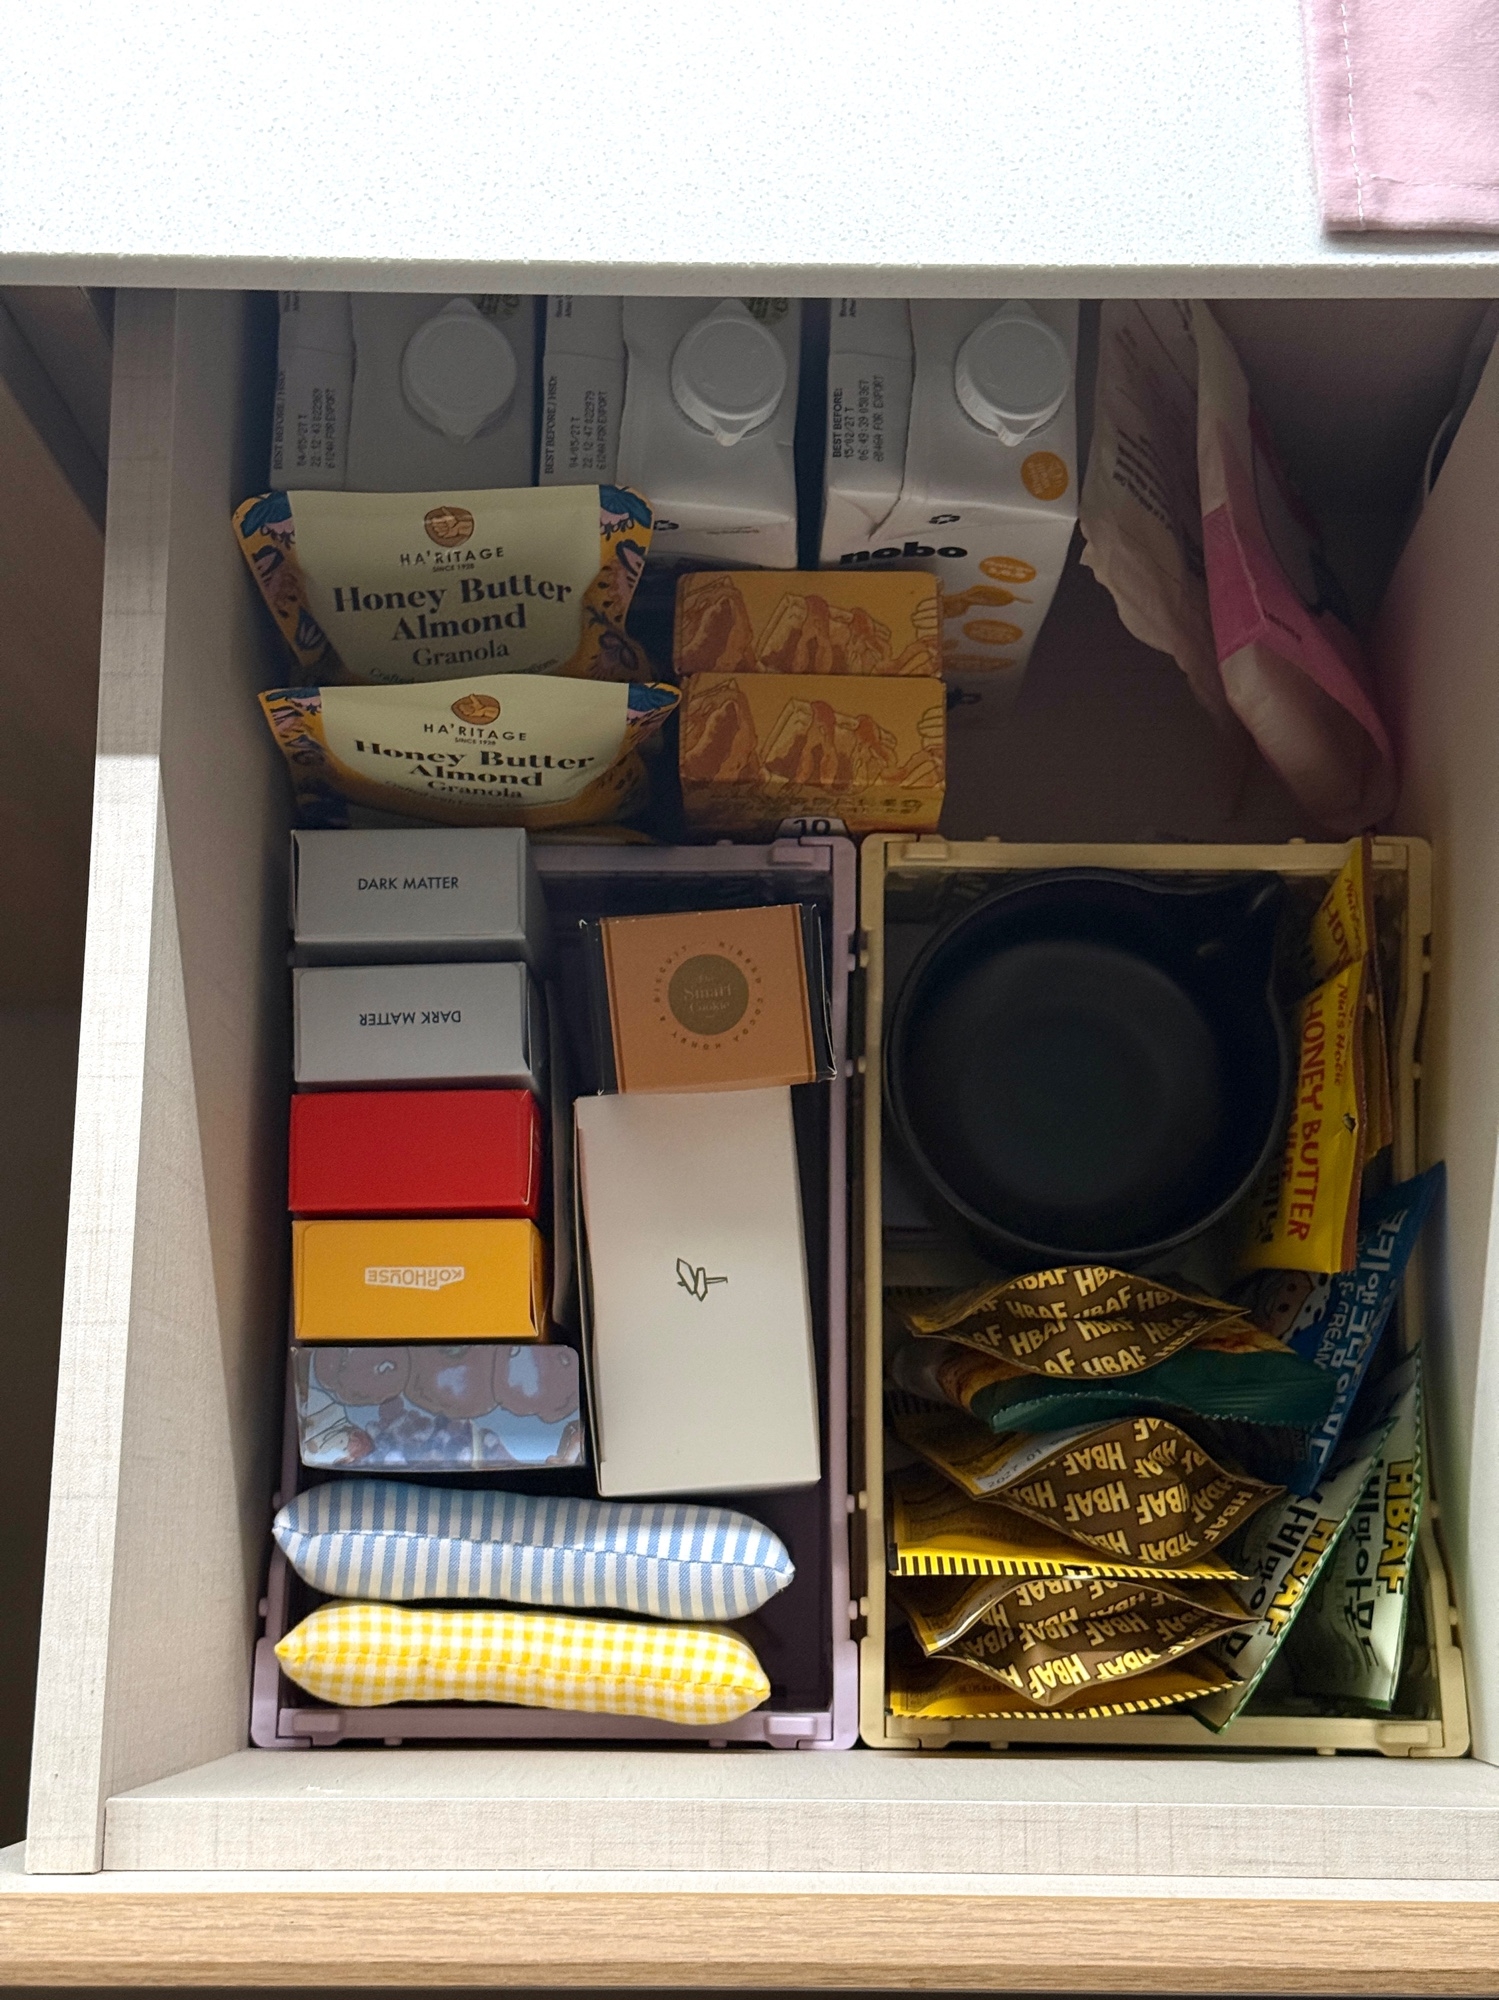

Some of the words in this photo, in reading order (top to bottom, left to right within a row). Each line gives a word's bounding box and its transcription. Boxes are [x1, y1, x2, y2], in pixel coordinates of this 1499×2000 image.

[596, 391, 608, 424] EXPORT
[873, 375, 885, 409] EXPORT
[275, 401, 285, 442] BEFORE
[833, 388, 843, 430] BEFORE:
[874, 413, 884, 431] FOR
[546, 406, 556, 446] BEFORE
[597, 424, 608, 442] FOR
[274, 443, 284, 470] BEST
[544, 448, 555, 474] BEST
[833, 433, 842, 458] BEST
[400, 546, 505, 565] HA'RITAGE
[432, 564, 455, 573] SINCE
[840, 541, 968, 565] nobo
[333, 586, 448, 613] Honey
[460, 574, 572, 603] Butter
[392, 603, 527, 641] Almond
[412, 640, 509, 667] Granola
[424, 723, 527, 741] HA'RITAGE
[455, 737, 477, 745] SINCE
[353, 740, 467, 765] Honey
[480, 750, 595, 770] Butter
[408, 764, 542, 787] Almond
[427, 781, 522, 798] Granola
[358, 877, 398, 890] DARK
[403, 876, 459, 890] MATTER
[653, 945, 688, 1003] BISCUIT
[683, 983, 732, 1000] Smart
[1337, 983, 1349, 1029] Nuts
[359, 1012, 416, 1026] MATTER
[421, 1010, 461, 1024] DARK
[733, 997, 764, 1042] COCOA
[671, 1031, 721, 1050] HONEY
[1300, 994, 1325, 1112] HONEY
[1287, 1118, 1322, 1241] BUTTER
[1008, 1319, 1067, 1356] HBAF
[1044, 1348, 1076, 1375] AF
[1063, 1441, 1128, 1476] HBAF
[1003, 1480, 1057, 1509] HBA
[1063, 1480, 1131, 1522] HBAF
[1136, 1482, 1190, 1525] HBAF
[1203, 1490, 1254, 1542] HBAF
[1377, 1458, 1414, 1595] HBAF
[1263, 1518, 1341, 1638] HBAF
[965, 1626, 1015, 1658] HBA
[1085, 1611, 1150, 1646] HBAF
[1027, 1653, 1091, 1699] HBAF
